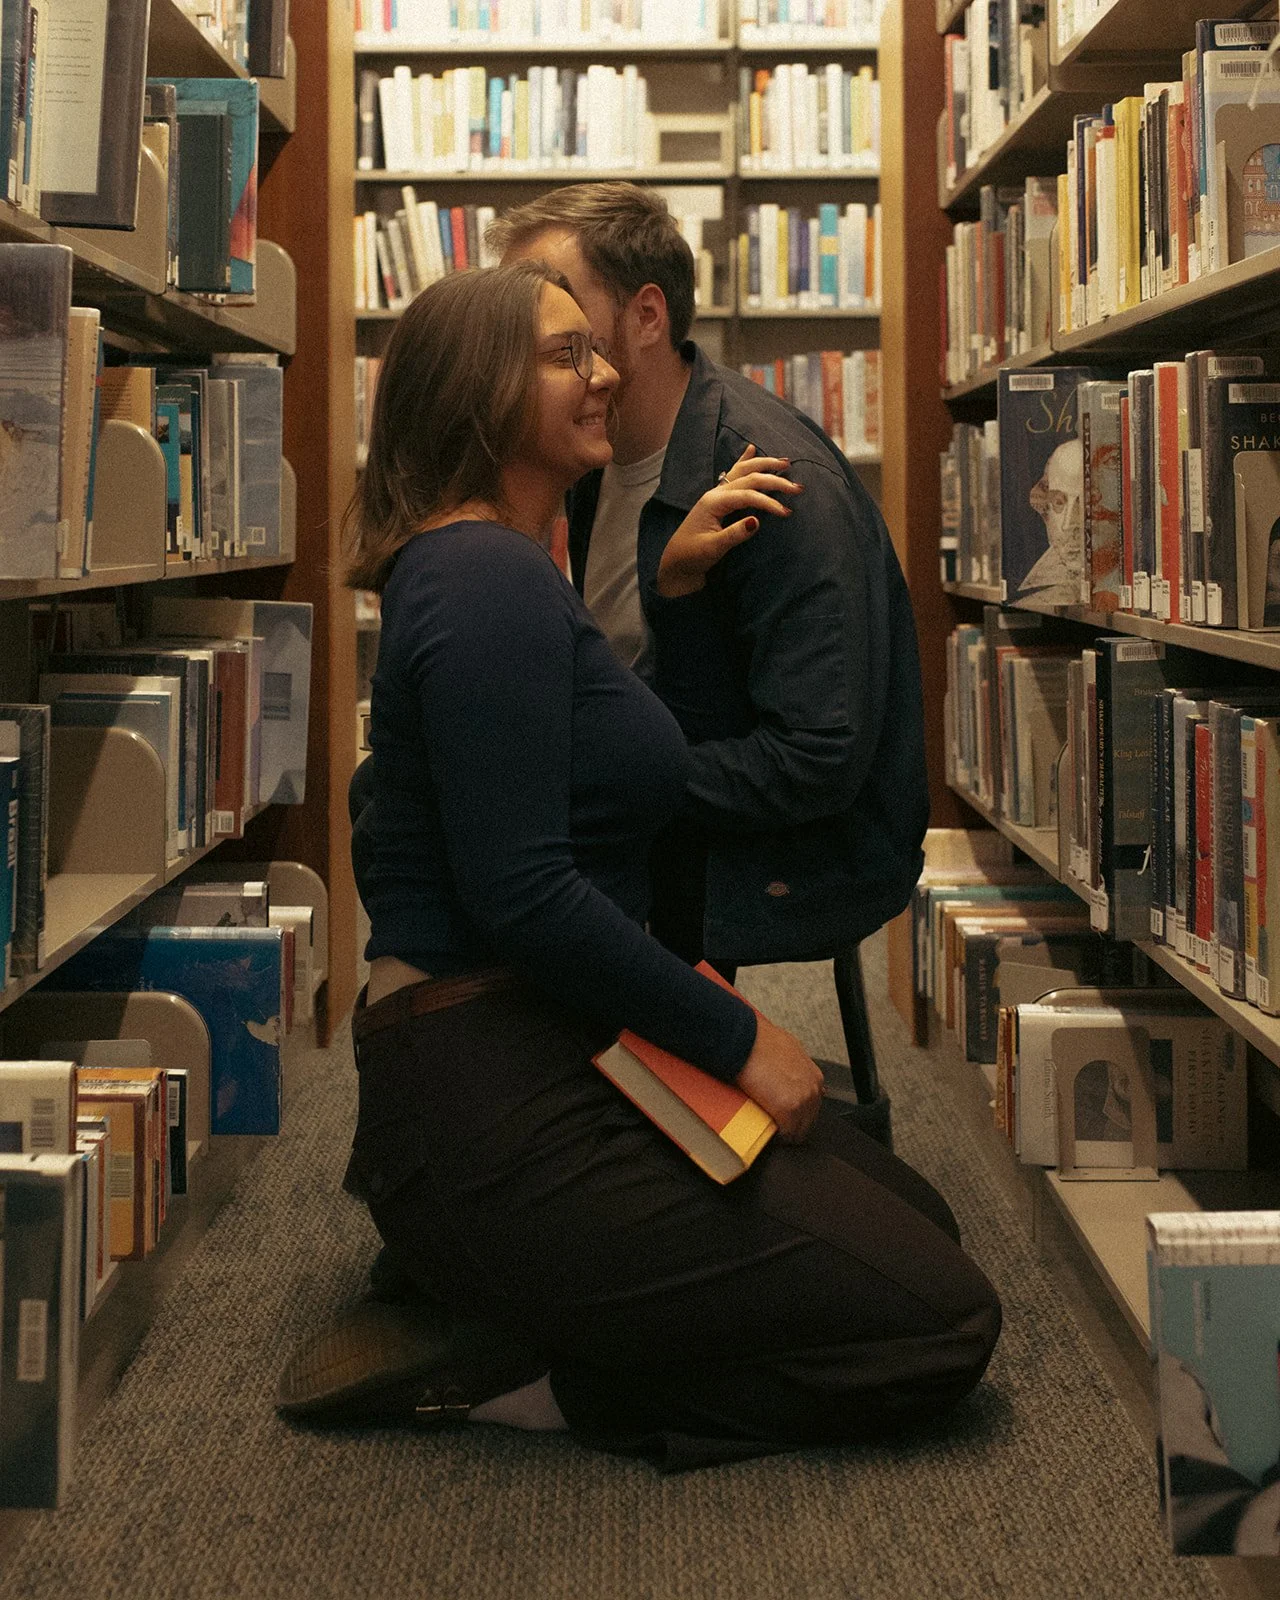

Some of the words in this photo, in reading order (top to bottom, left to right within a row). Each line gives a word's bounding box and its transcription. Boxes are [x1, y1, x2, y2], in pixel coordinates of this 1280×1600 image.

[28, 61, 36, 117] IDAHO
[1026, 388, 1078, 434] Sh
[1084, 416, 1092, 575] SHAKESPEARE
[1113, 750, 1132, 761] King
[1223, 756, 1235, 882] SHAKESPEARE
